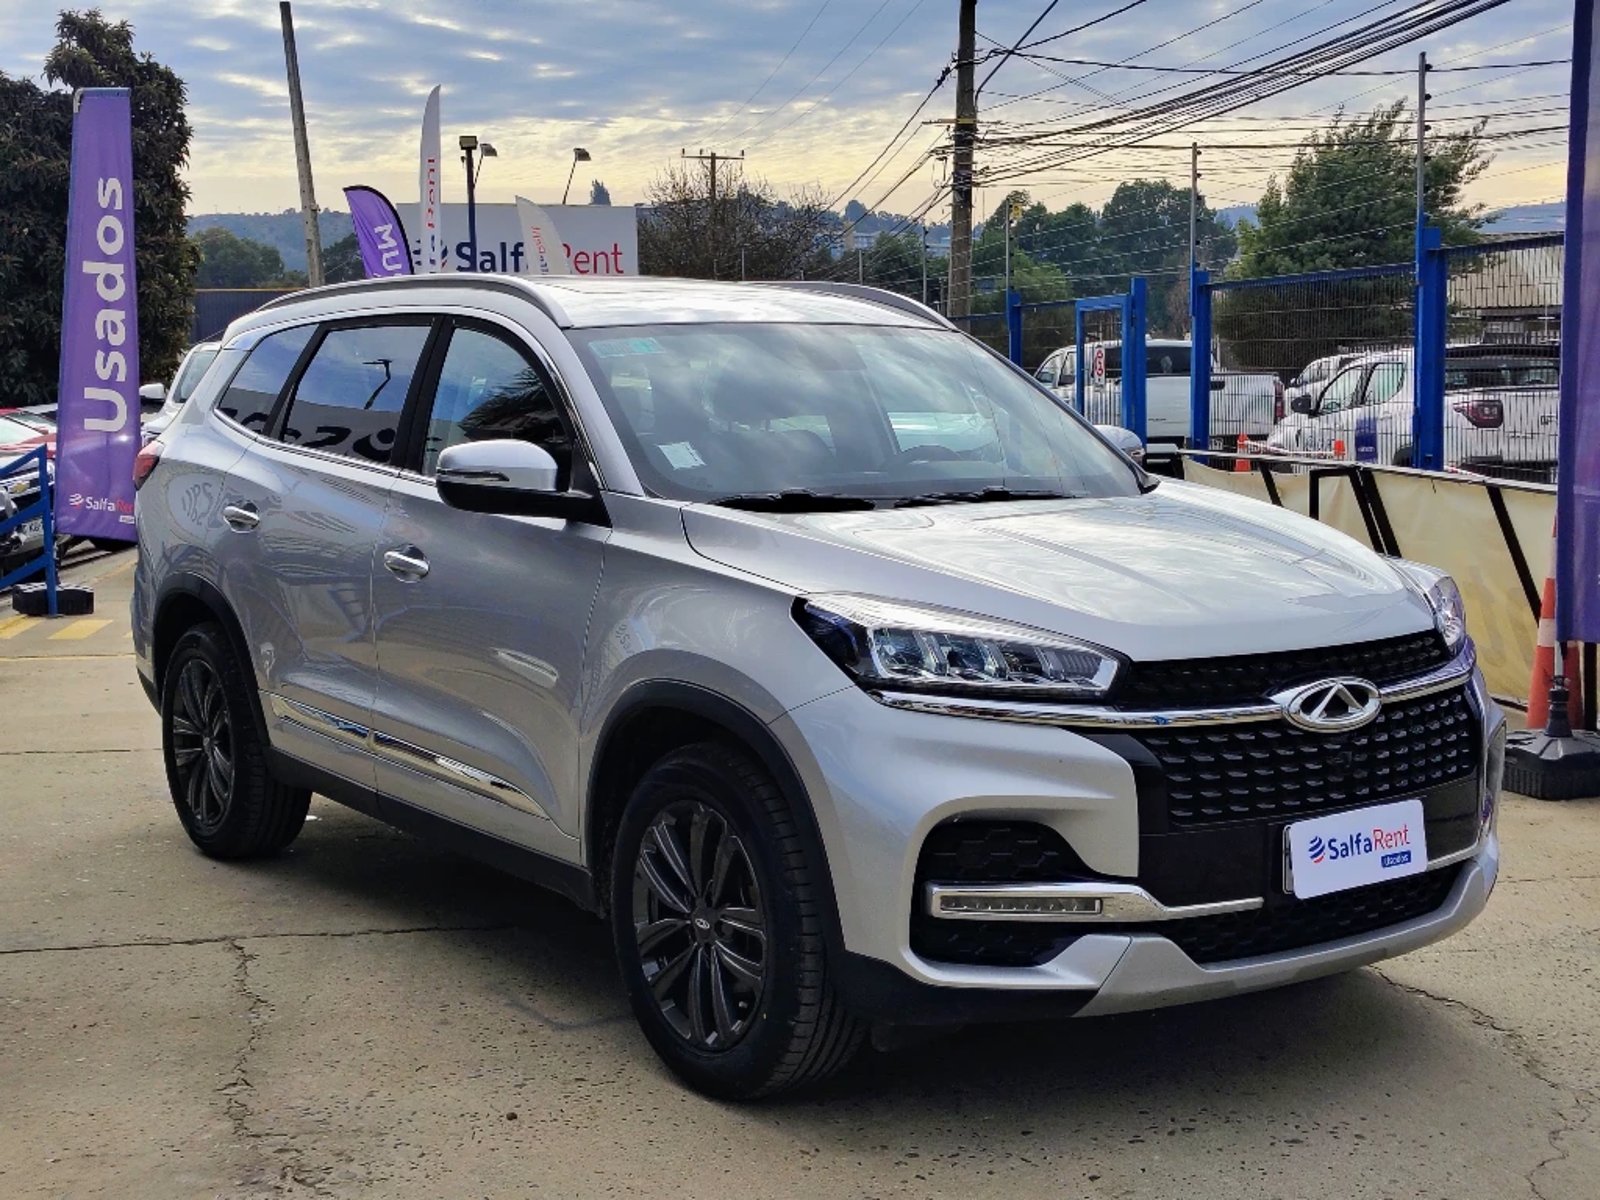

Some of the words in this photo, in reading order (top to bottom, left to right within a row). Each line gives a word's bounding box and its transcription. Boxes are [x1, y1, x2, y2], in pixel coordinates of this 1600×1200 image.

[374, 223, 402, 276] MU
[82, 177, 127, 432] Usados
[1328, 824, 1410, 860] SalfaRent
